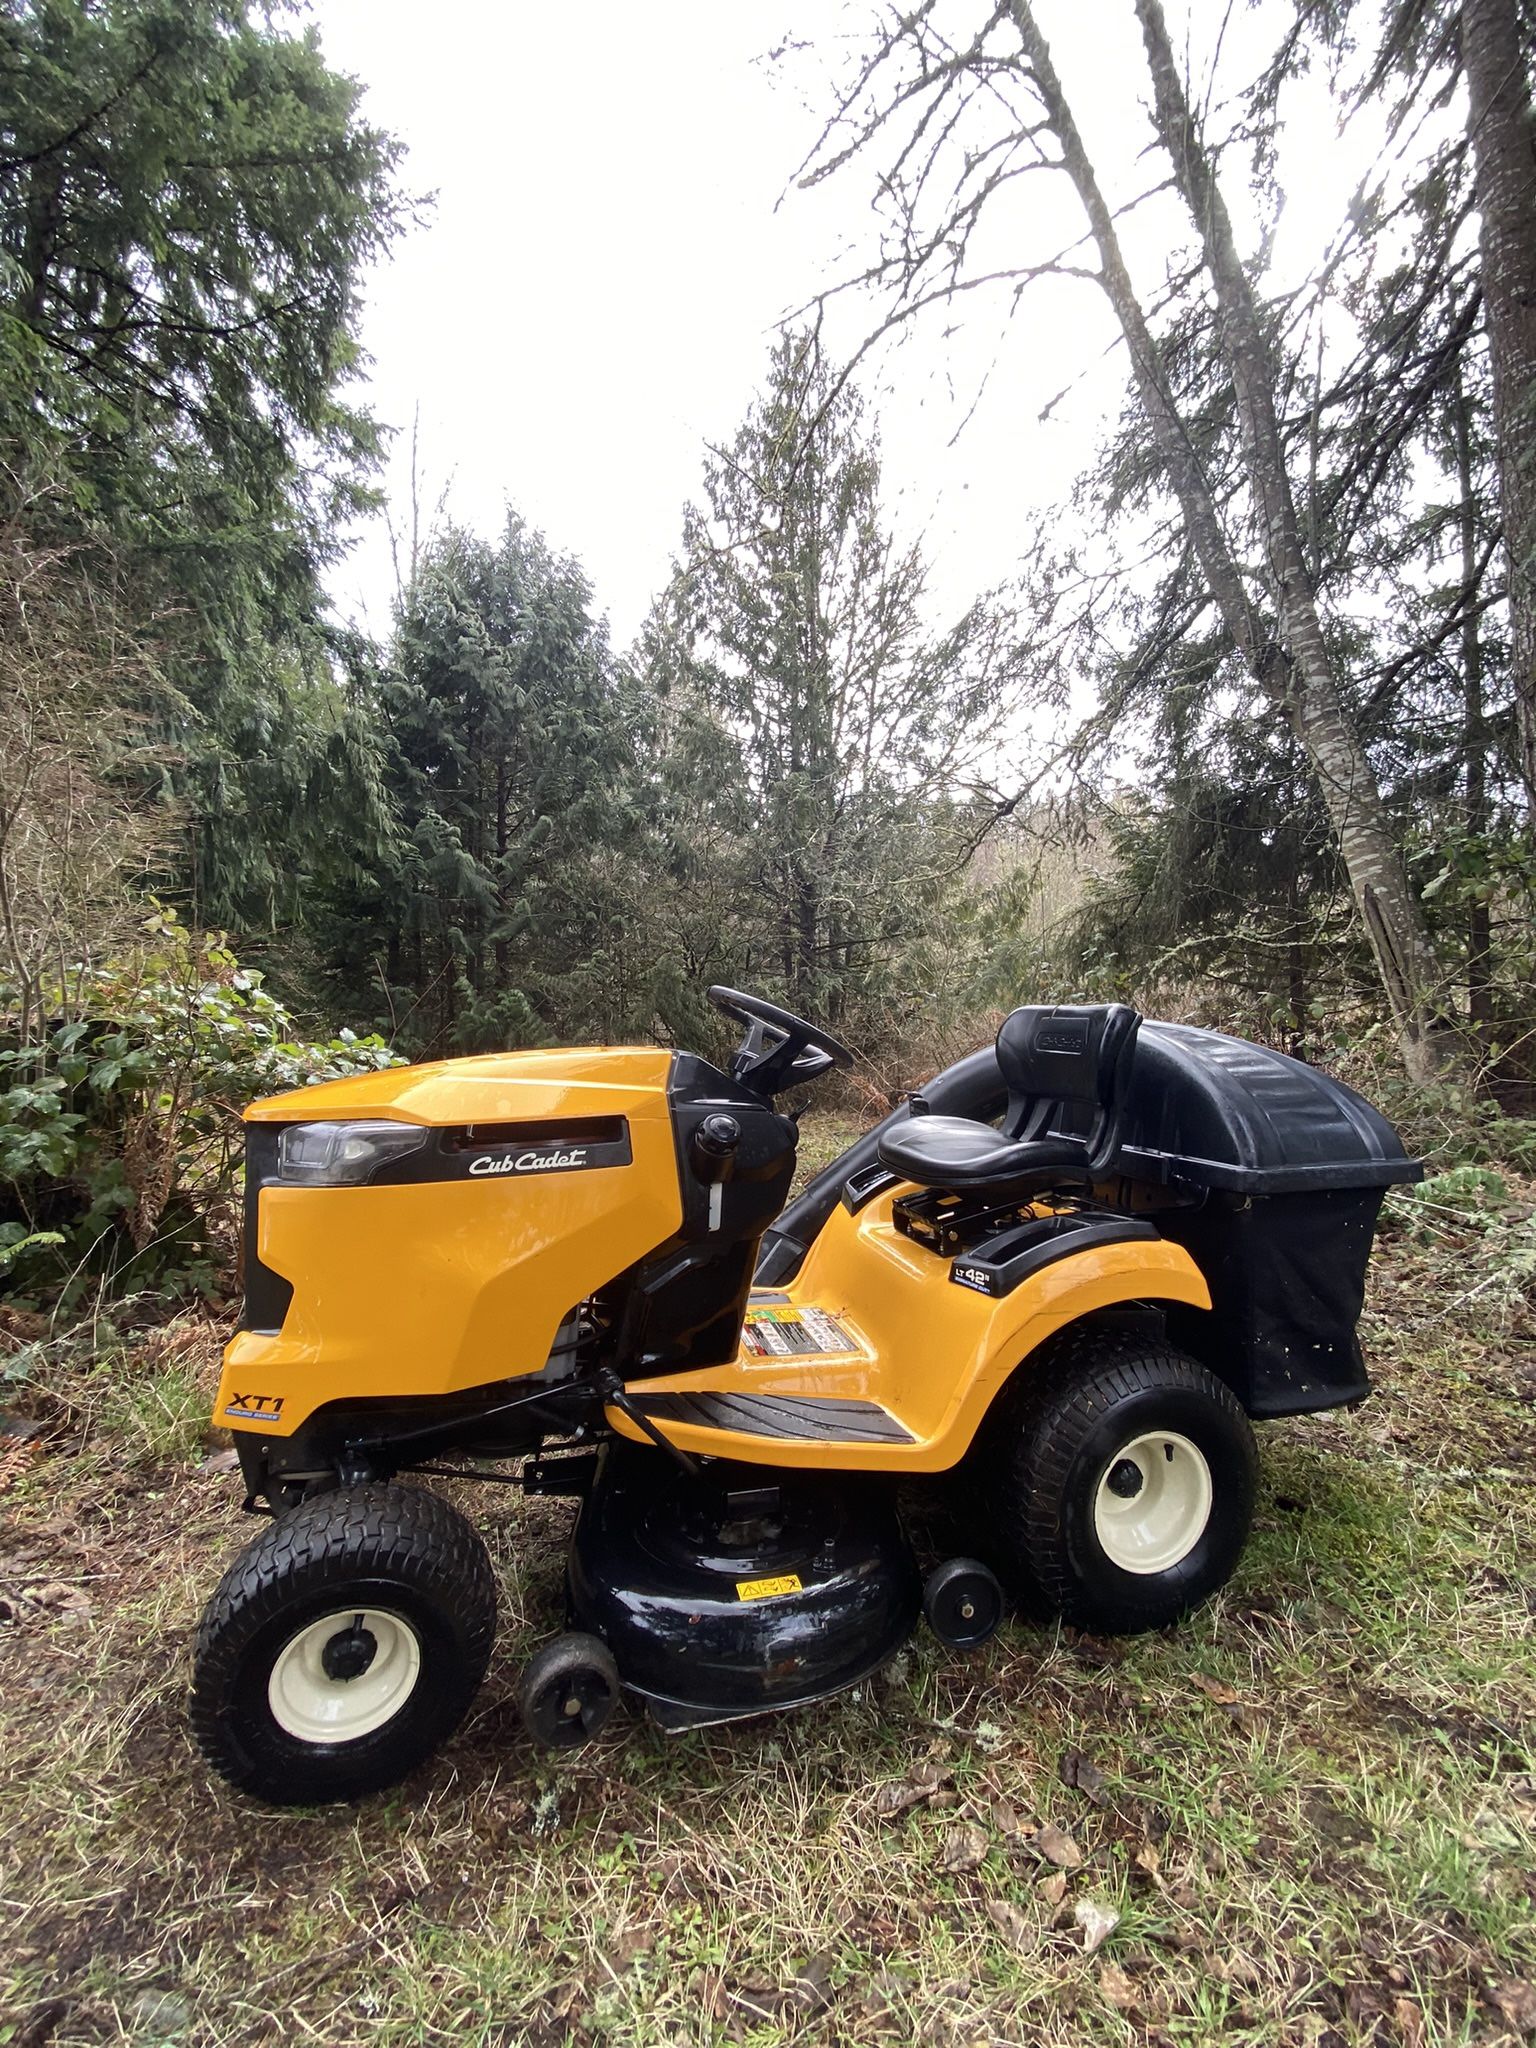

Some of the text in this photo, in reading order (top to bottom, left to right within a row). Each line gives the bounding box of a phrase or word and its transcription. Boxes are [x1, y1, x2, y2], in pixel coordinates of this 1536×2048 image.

[469, 1149, 586, 1175] Cub Cadet
[955, 1268, 965, 1277] LT
[227, 1392, 285, 1412] XT1
